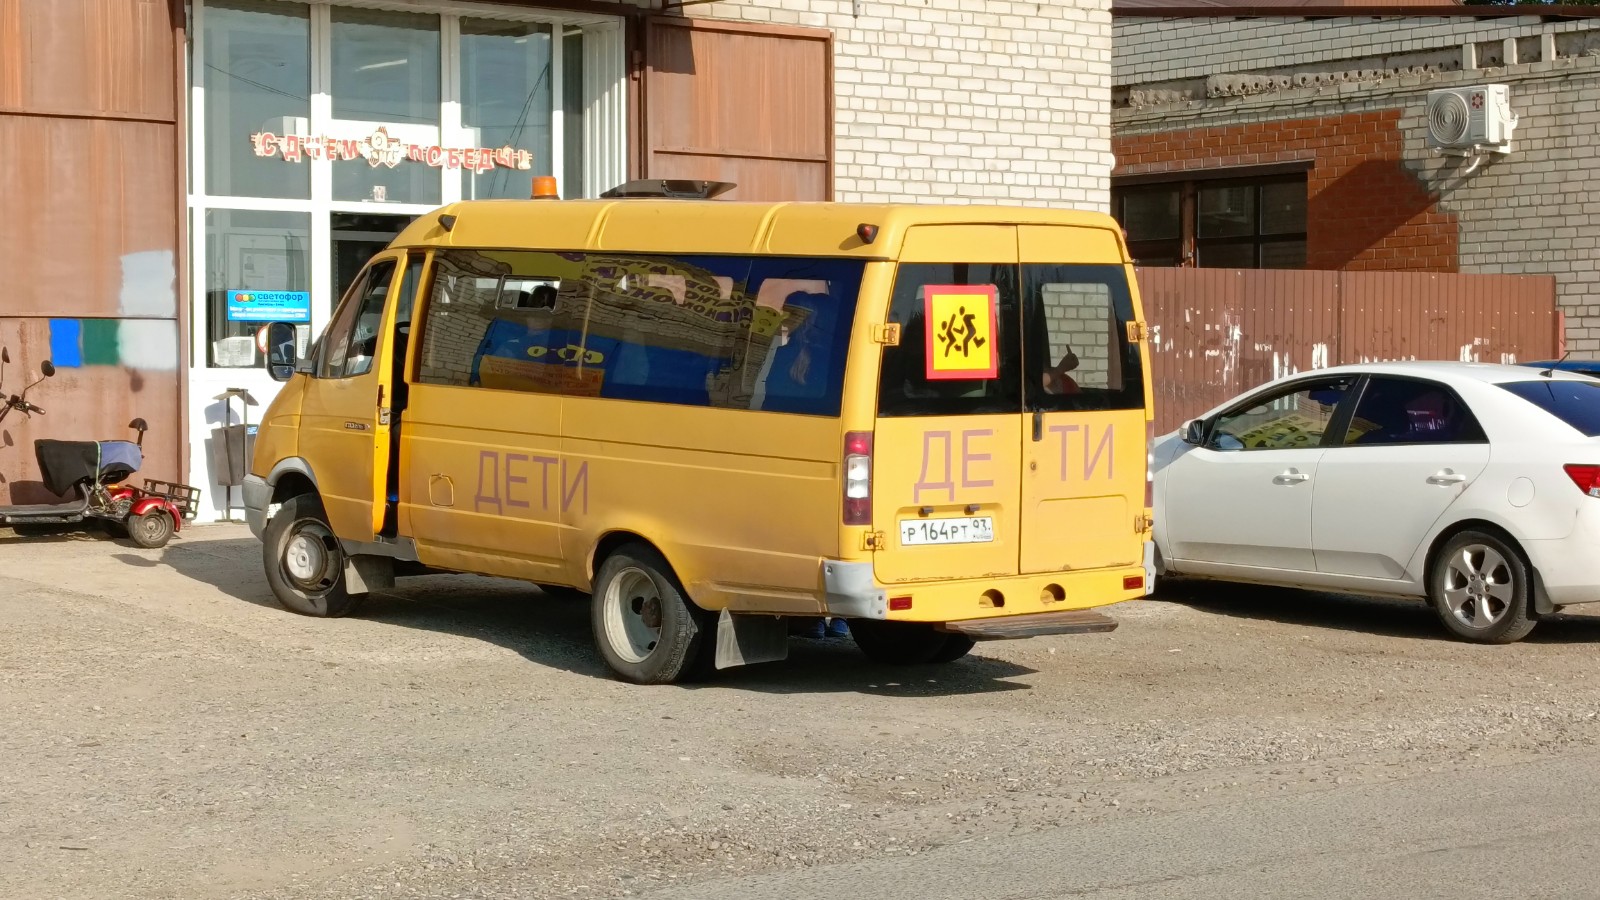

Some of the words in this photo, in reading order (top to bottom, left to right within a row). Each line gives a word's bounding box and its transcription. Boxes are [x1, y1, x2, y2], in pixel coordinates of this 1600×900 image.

[261, 133, 277, 155] С
[284, 135, 360, 161] ДНЕМ
[474, 450, 588, 515] ДЕТИ
